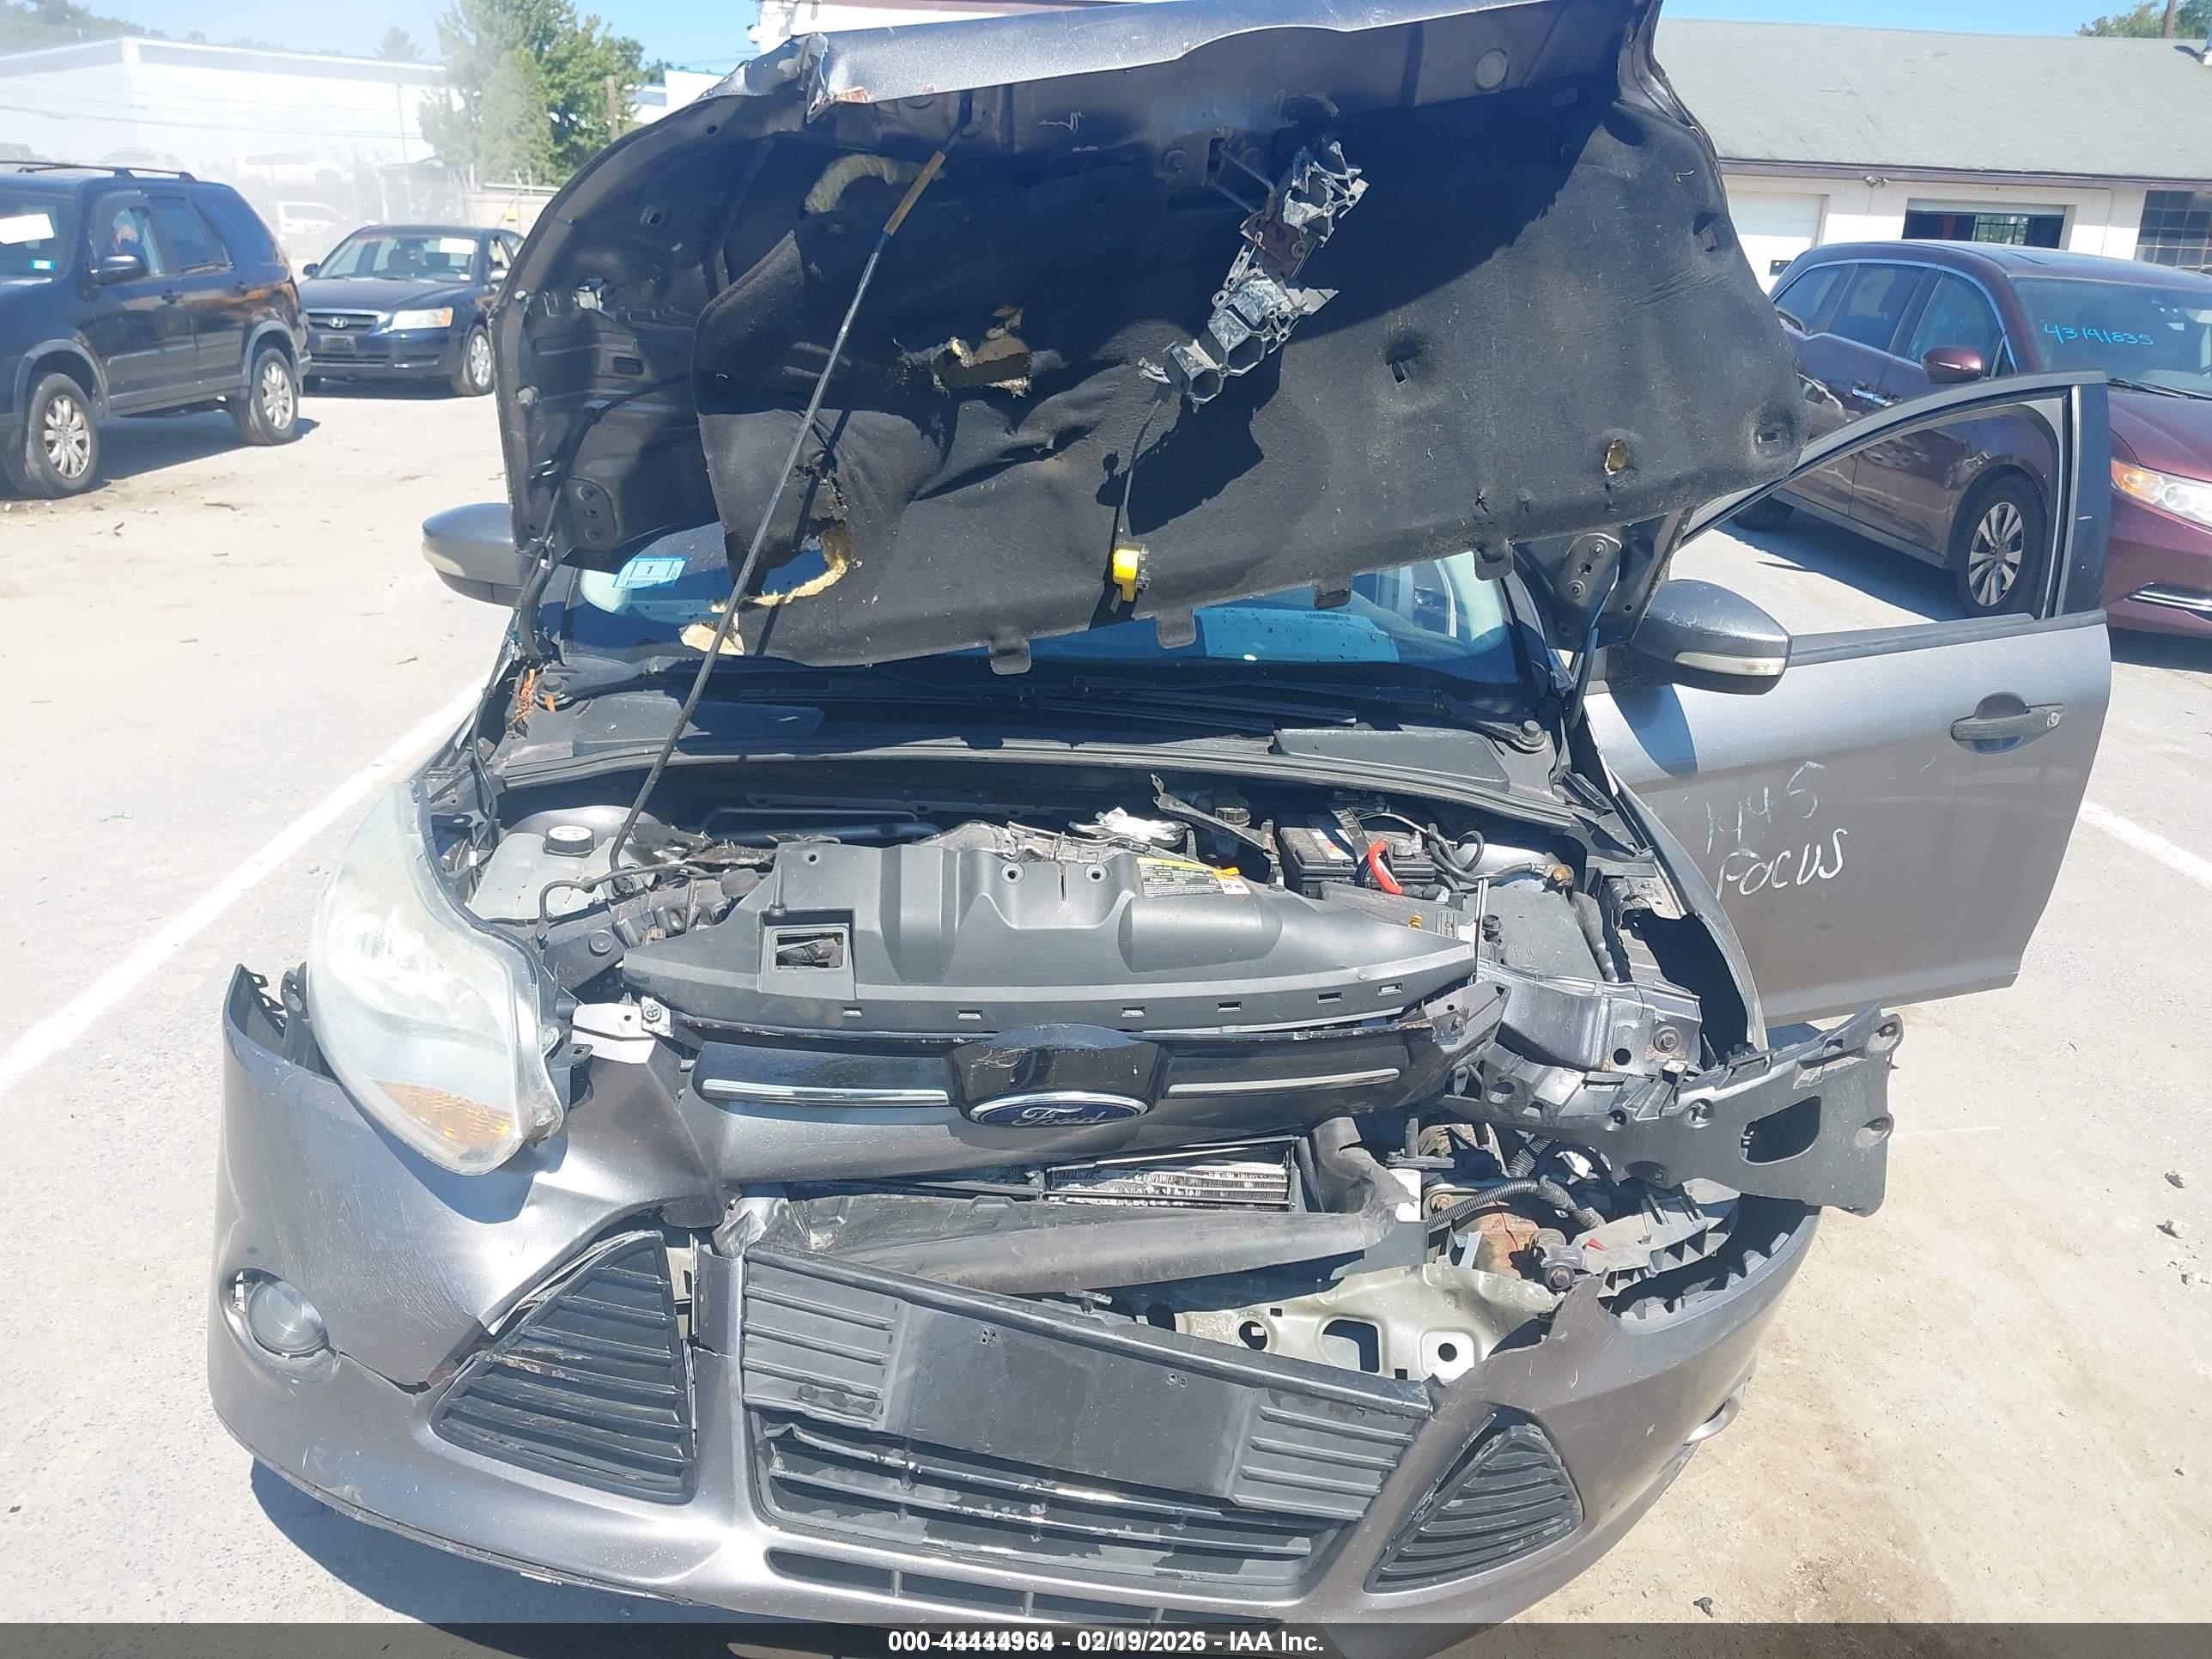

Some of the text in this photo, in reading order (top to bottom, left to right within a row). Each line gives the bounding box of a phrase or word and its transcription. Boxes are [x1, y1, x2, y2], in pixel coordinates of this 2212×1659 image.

[2044, 323, 2154, 345] 43191835
[1716, 827, 1848, 902] FOCUS
[1012, 1107, 1106, 1126] Ford
